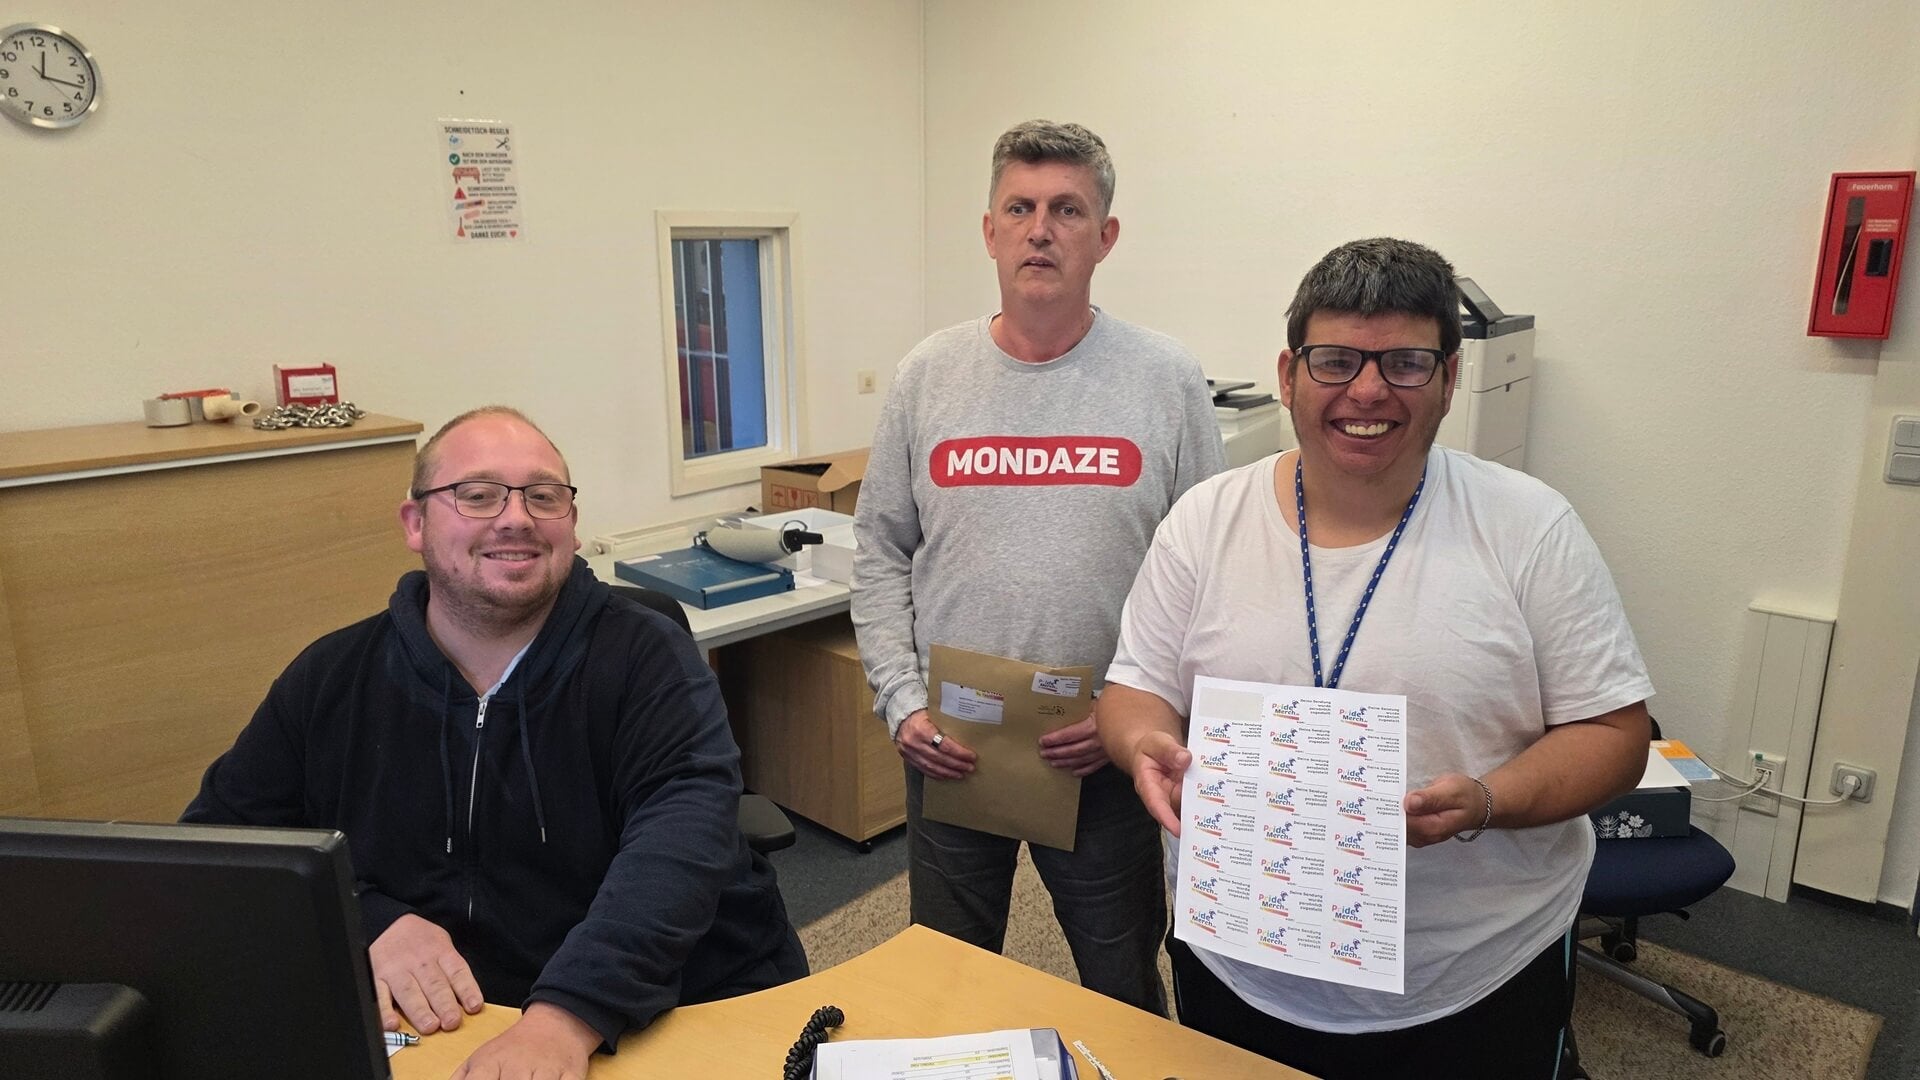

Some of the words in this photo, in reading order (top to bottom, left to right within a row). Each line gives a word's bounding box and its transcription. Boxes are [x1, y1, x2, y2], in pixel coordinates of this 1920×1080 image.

[13, 41, 24, 51] 11
[30, 36, 45, 47] 12
[54, 42, 59, 53] 1
[2, 52, 17, 62] 10
[68, 57, 78, 67] 2
[0, 69, 9, 79] 9
[77, 74, 85, 84] 3
[8, 87, 18, 97] 8
[74, 92, 83, 100] 4
[24, 101, 34, 111] 7
[44, 106, 53, 115] 6
[63, 102, 72, 112] 5
[947, 446, 1120, 477] MONDAZE
